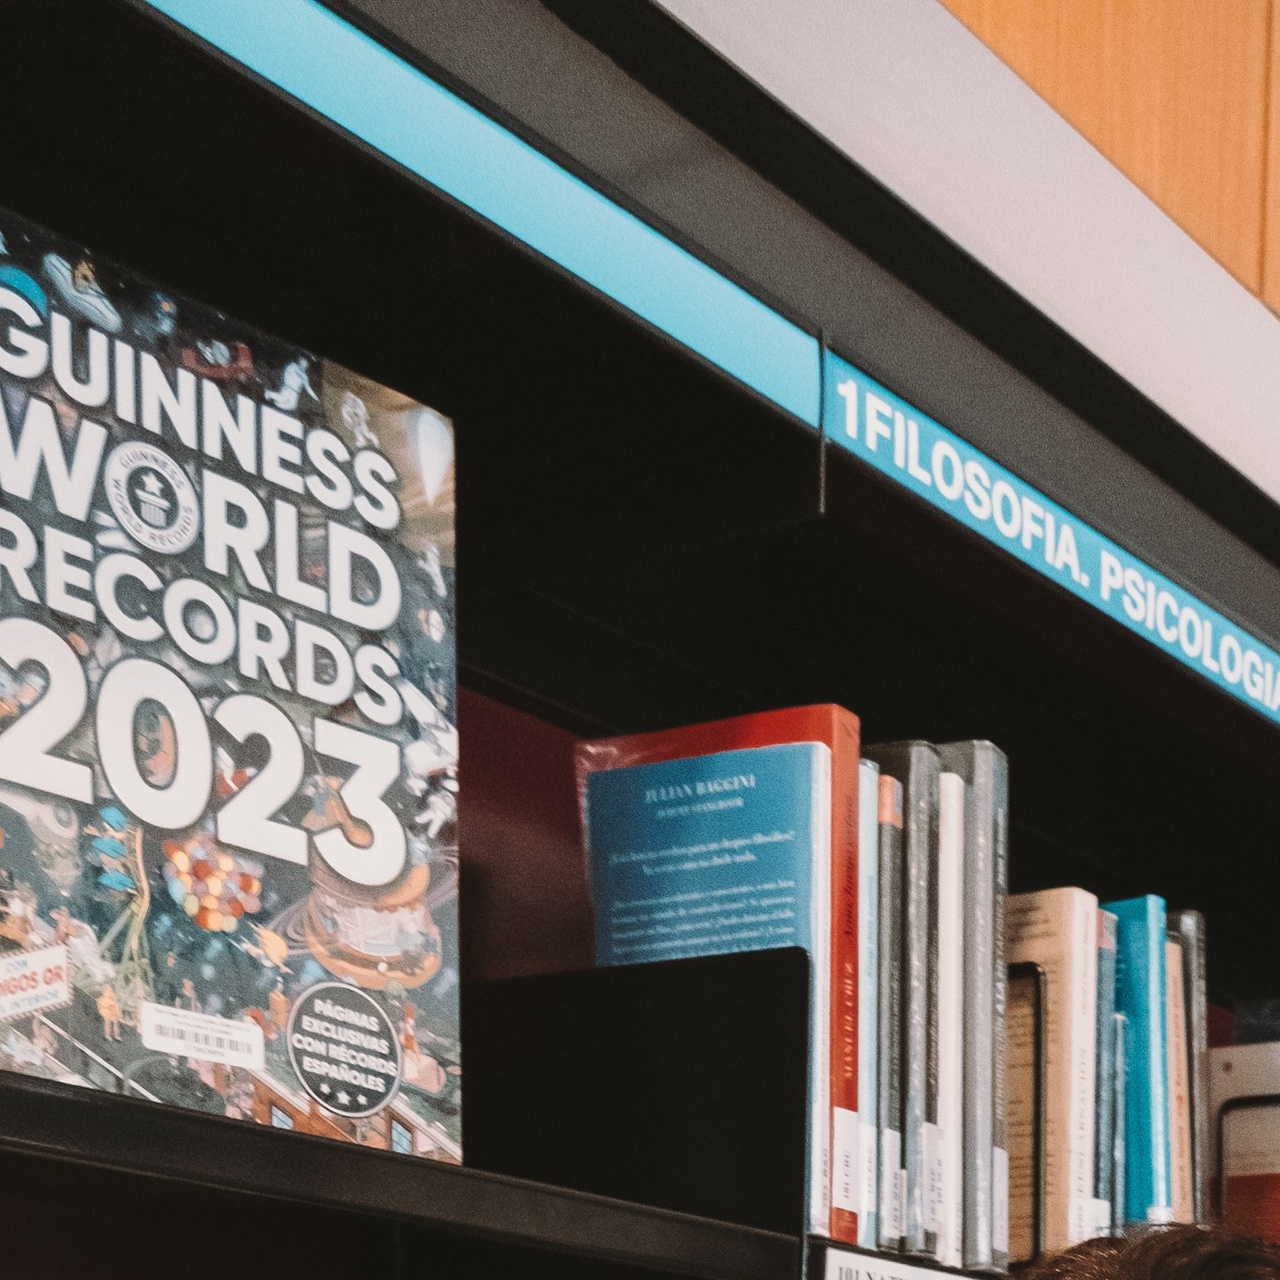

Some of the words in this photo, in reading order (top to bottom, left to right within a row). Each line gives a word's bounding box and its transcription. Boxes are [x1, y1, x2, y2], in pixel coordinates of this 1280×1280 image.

[0, 285, 402, 531] GUINNESS
[0, 510, 403, 725] RECORDS
[0, 618, 407, 886] 2023
[301, 1015, 390, 1054] EXCLUSIVAS
[314, 998, 380, 1032] PÁGINAS
[292, 1033, 328, 1056] CON
[328, 1043, 397, 1077] RÉCORDS
[302, 1056, 386, 1092] ESPAÑOLES
